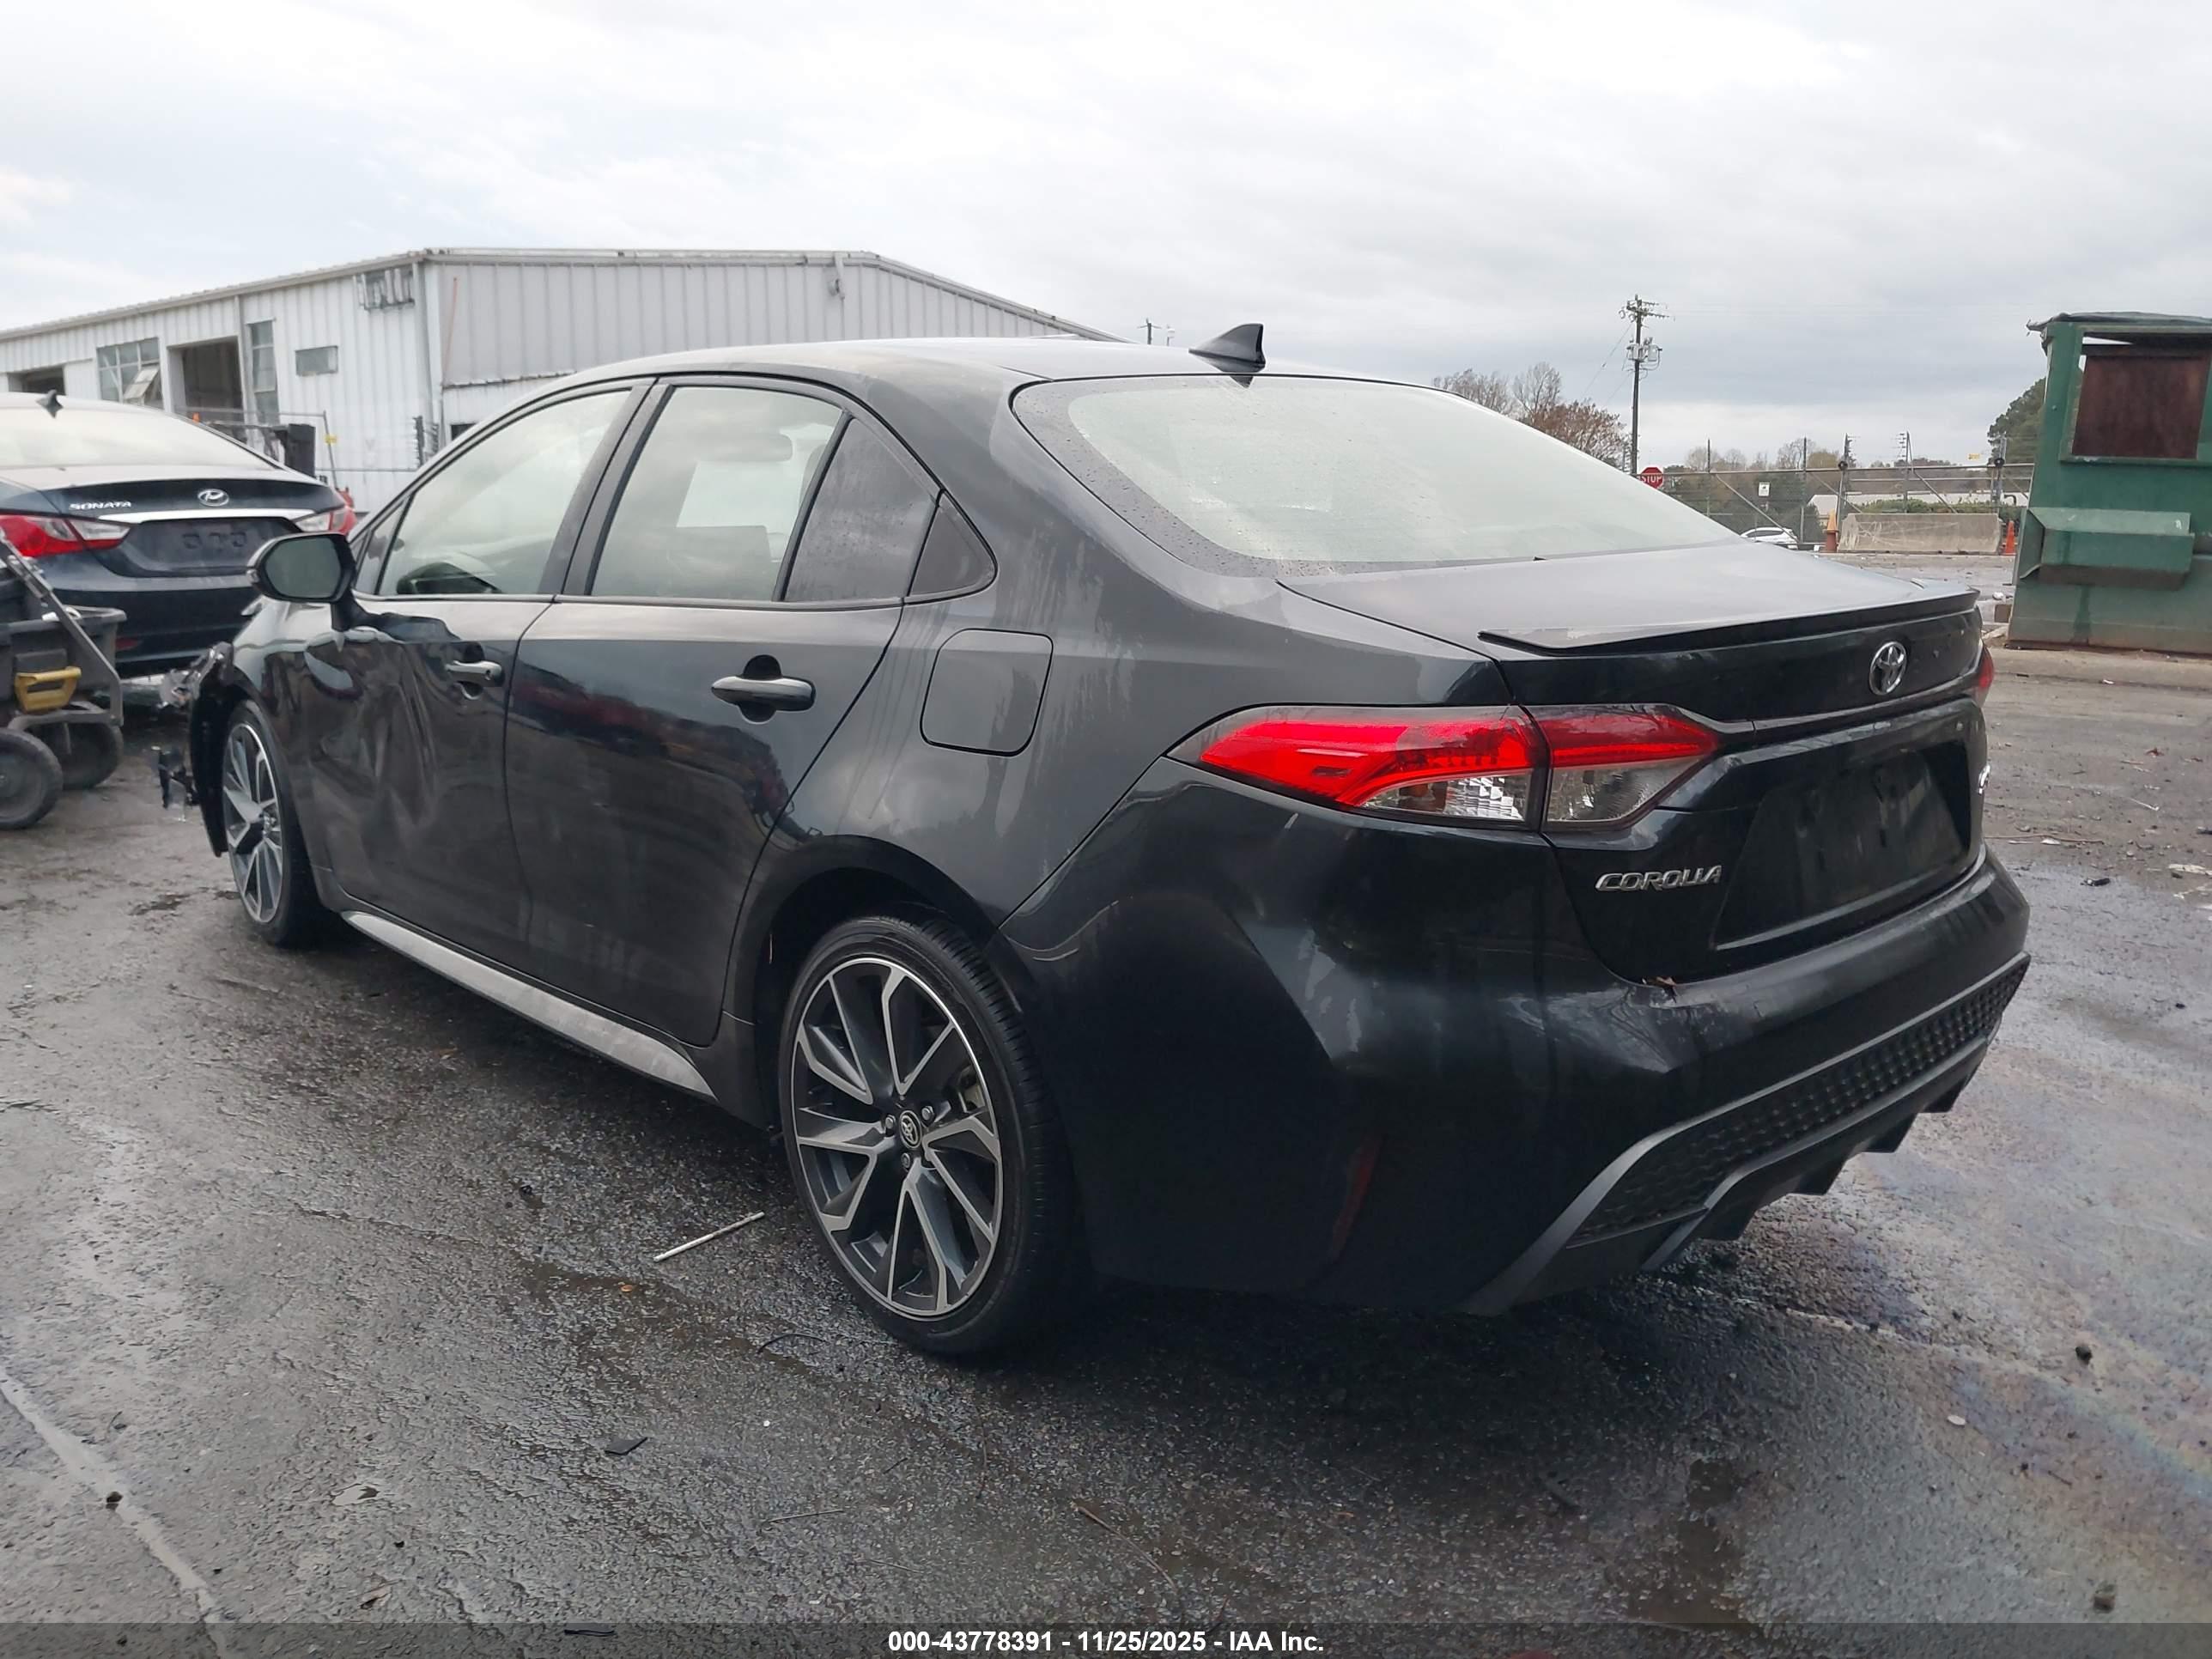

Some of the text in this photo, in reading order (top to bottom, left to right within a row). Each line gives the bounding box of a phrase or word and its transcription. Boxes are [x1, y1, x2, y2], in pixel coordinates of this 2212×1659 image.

[1642, 475, 1662, 483] STOP
[70, 501, 131, 510] SONATA
[1595, 865, 1722, 891] COROLLA
